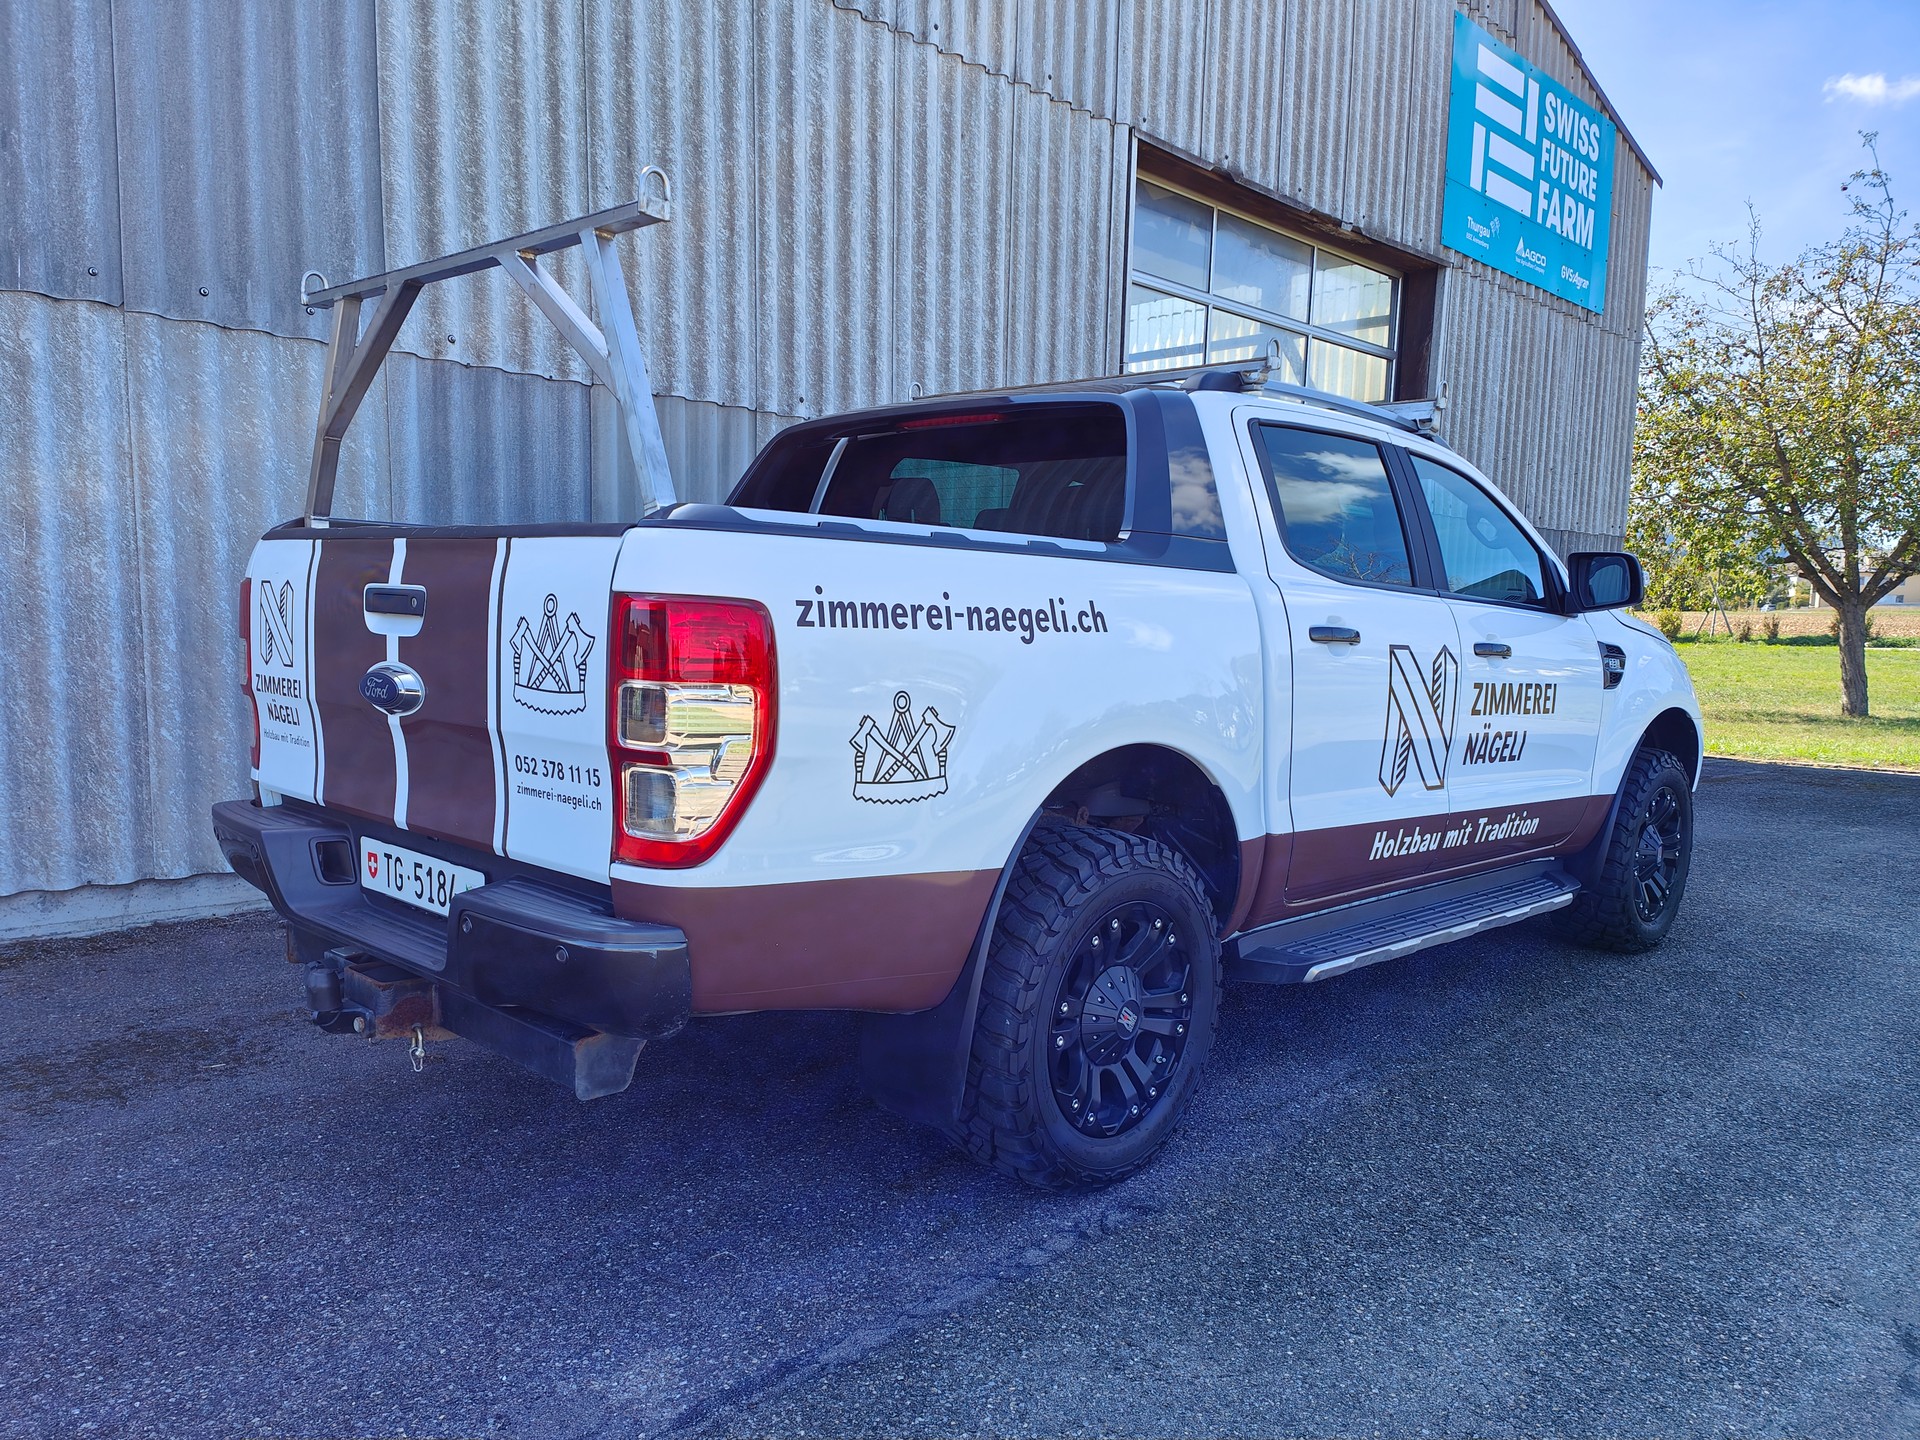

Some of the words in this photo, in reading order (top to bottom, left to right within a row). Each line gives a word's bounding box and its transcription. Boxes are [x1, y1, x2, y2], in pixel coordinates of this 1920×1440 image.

[1543, 91, 1600, 162] SWISS
[1540, 137, 1597, 202] FUTURE
[1467, 215, 1490, 238] Thurgau
[1536, 179, 1595, 250] FARM
[1524, 248, 1547, 267] AGCO
[795, 585, 1108, 644] zimmerei-naegeli.ch
[255, 673, 302, 699] ZIMMEREI
[364, 676, 389, 699] Ford
[1471, 682, 1557, 716] ZIMMEREI
[266, 698, 301, 726] NÄGELI
[263, 728, 280, 741] Holzbau
[280, 732, 289, 743] mit
[289, 733, 310, 748] Tradition
[1462, 723, 1527, 765] NÄGELI
[515, 754, 538, 776] 052
[541, 759, 565, 780] 378
[568, 764, 581, 784] 11
[585, 767, 601, 787] 15
[516, 781, 602, 811] zimmerei-naegeli.ch
[1368, 826, 1441, 861] Holzbau
[1443, 821, 1472, 849] mit
[1474, 811, 1540, 844] Tradition
